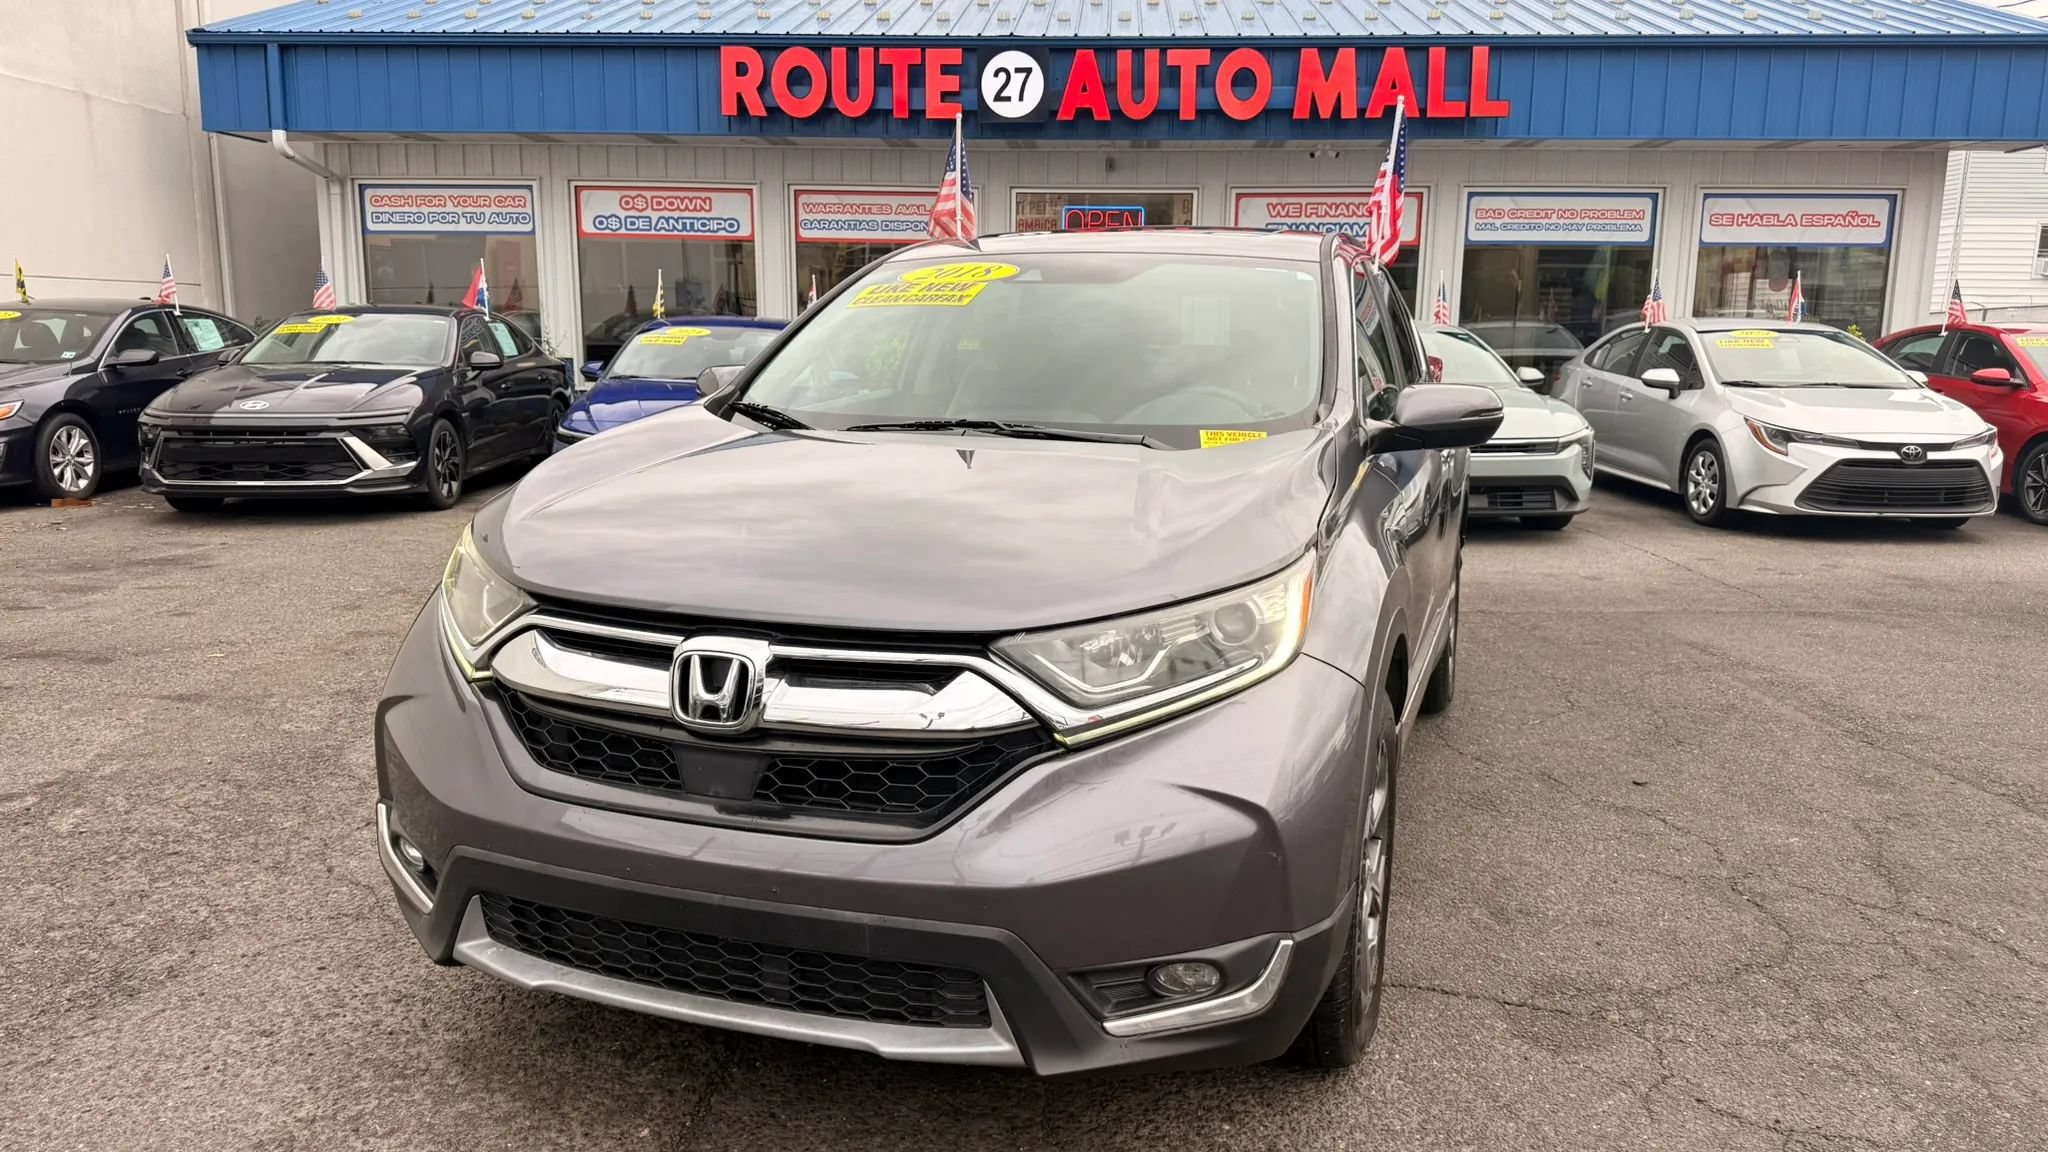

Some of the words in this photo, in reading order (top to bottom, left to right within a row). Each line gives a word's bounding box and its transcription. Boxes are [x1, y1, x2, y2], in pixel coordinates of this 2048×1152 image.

[720, 45, 963, 119] ROUTE
[992, 67, 1033, 102] 27
[1056, 47, 1273, 121] AUTO
[1292, 46, 1509, 119] MALL
[370, 195, 412, 208] CASH
[415, 195, 446, 208] FOR
[448, 195, 491, 208] YOUR
[495, 195, 527, 208] CAR
[650, 196, 712, 212] DOWN
[803, 203, 893, 216] WARRANTIES
[895, 203, 933, 215] AVAIL
[1265, 202, 1302, 217] WE
[1305, 203, 1372, 217] FINANC
[1476, 209, 1504, 219] BAD
[1508, 209, 1555, 220] CREDIT
[1557, 209, 1578, 220] NO
[1580, 209, 1645, 220] PROBLEM
[371, 212, 425, 224] DINERO
[428, 212, 459, 224] POR
[462, 212, 486, 224] TU
[488, 212, 532, 225] AUTO
[625, 217, 651, 232] DE
[654, 217, 740, 233] ANTICIPO
[800, 219, 879, 231] GARANTIAS
[881, 220, 929, 231] DISPON
[1065, 209, 1143, 229] OPEN
[1709, 213, 1734, 226] SE
[1736, 213, 1798, 226] HABLA
[1800, 211, 1881, 228] ESPAÑOL
[1475, 223, 1499, 231] MAL
[1500, 223, 1544, 232] CREDITO
[1546, 223, 1561, 232] NO
[1563, 223, 1585, 231] HAY
[1586, 223, 1643, 232] PROBLEMA
[913, 265, 1003, 282] 2018
[866, 282, 918, 294] LIKE
[919, 281, 977, 293] NEW
[852, 293, 904, 306] CLEAN
[903, 292, 972, 304] CARFAX
